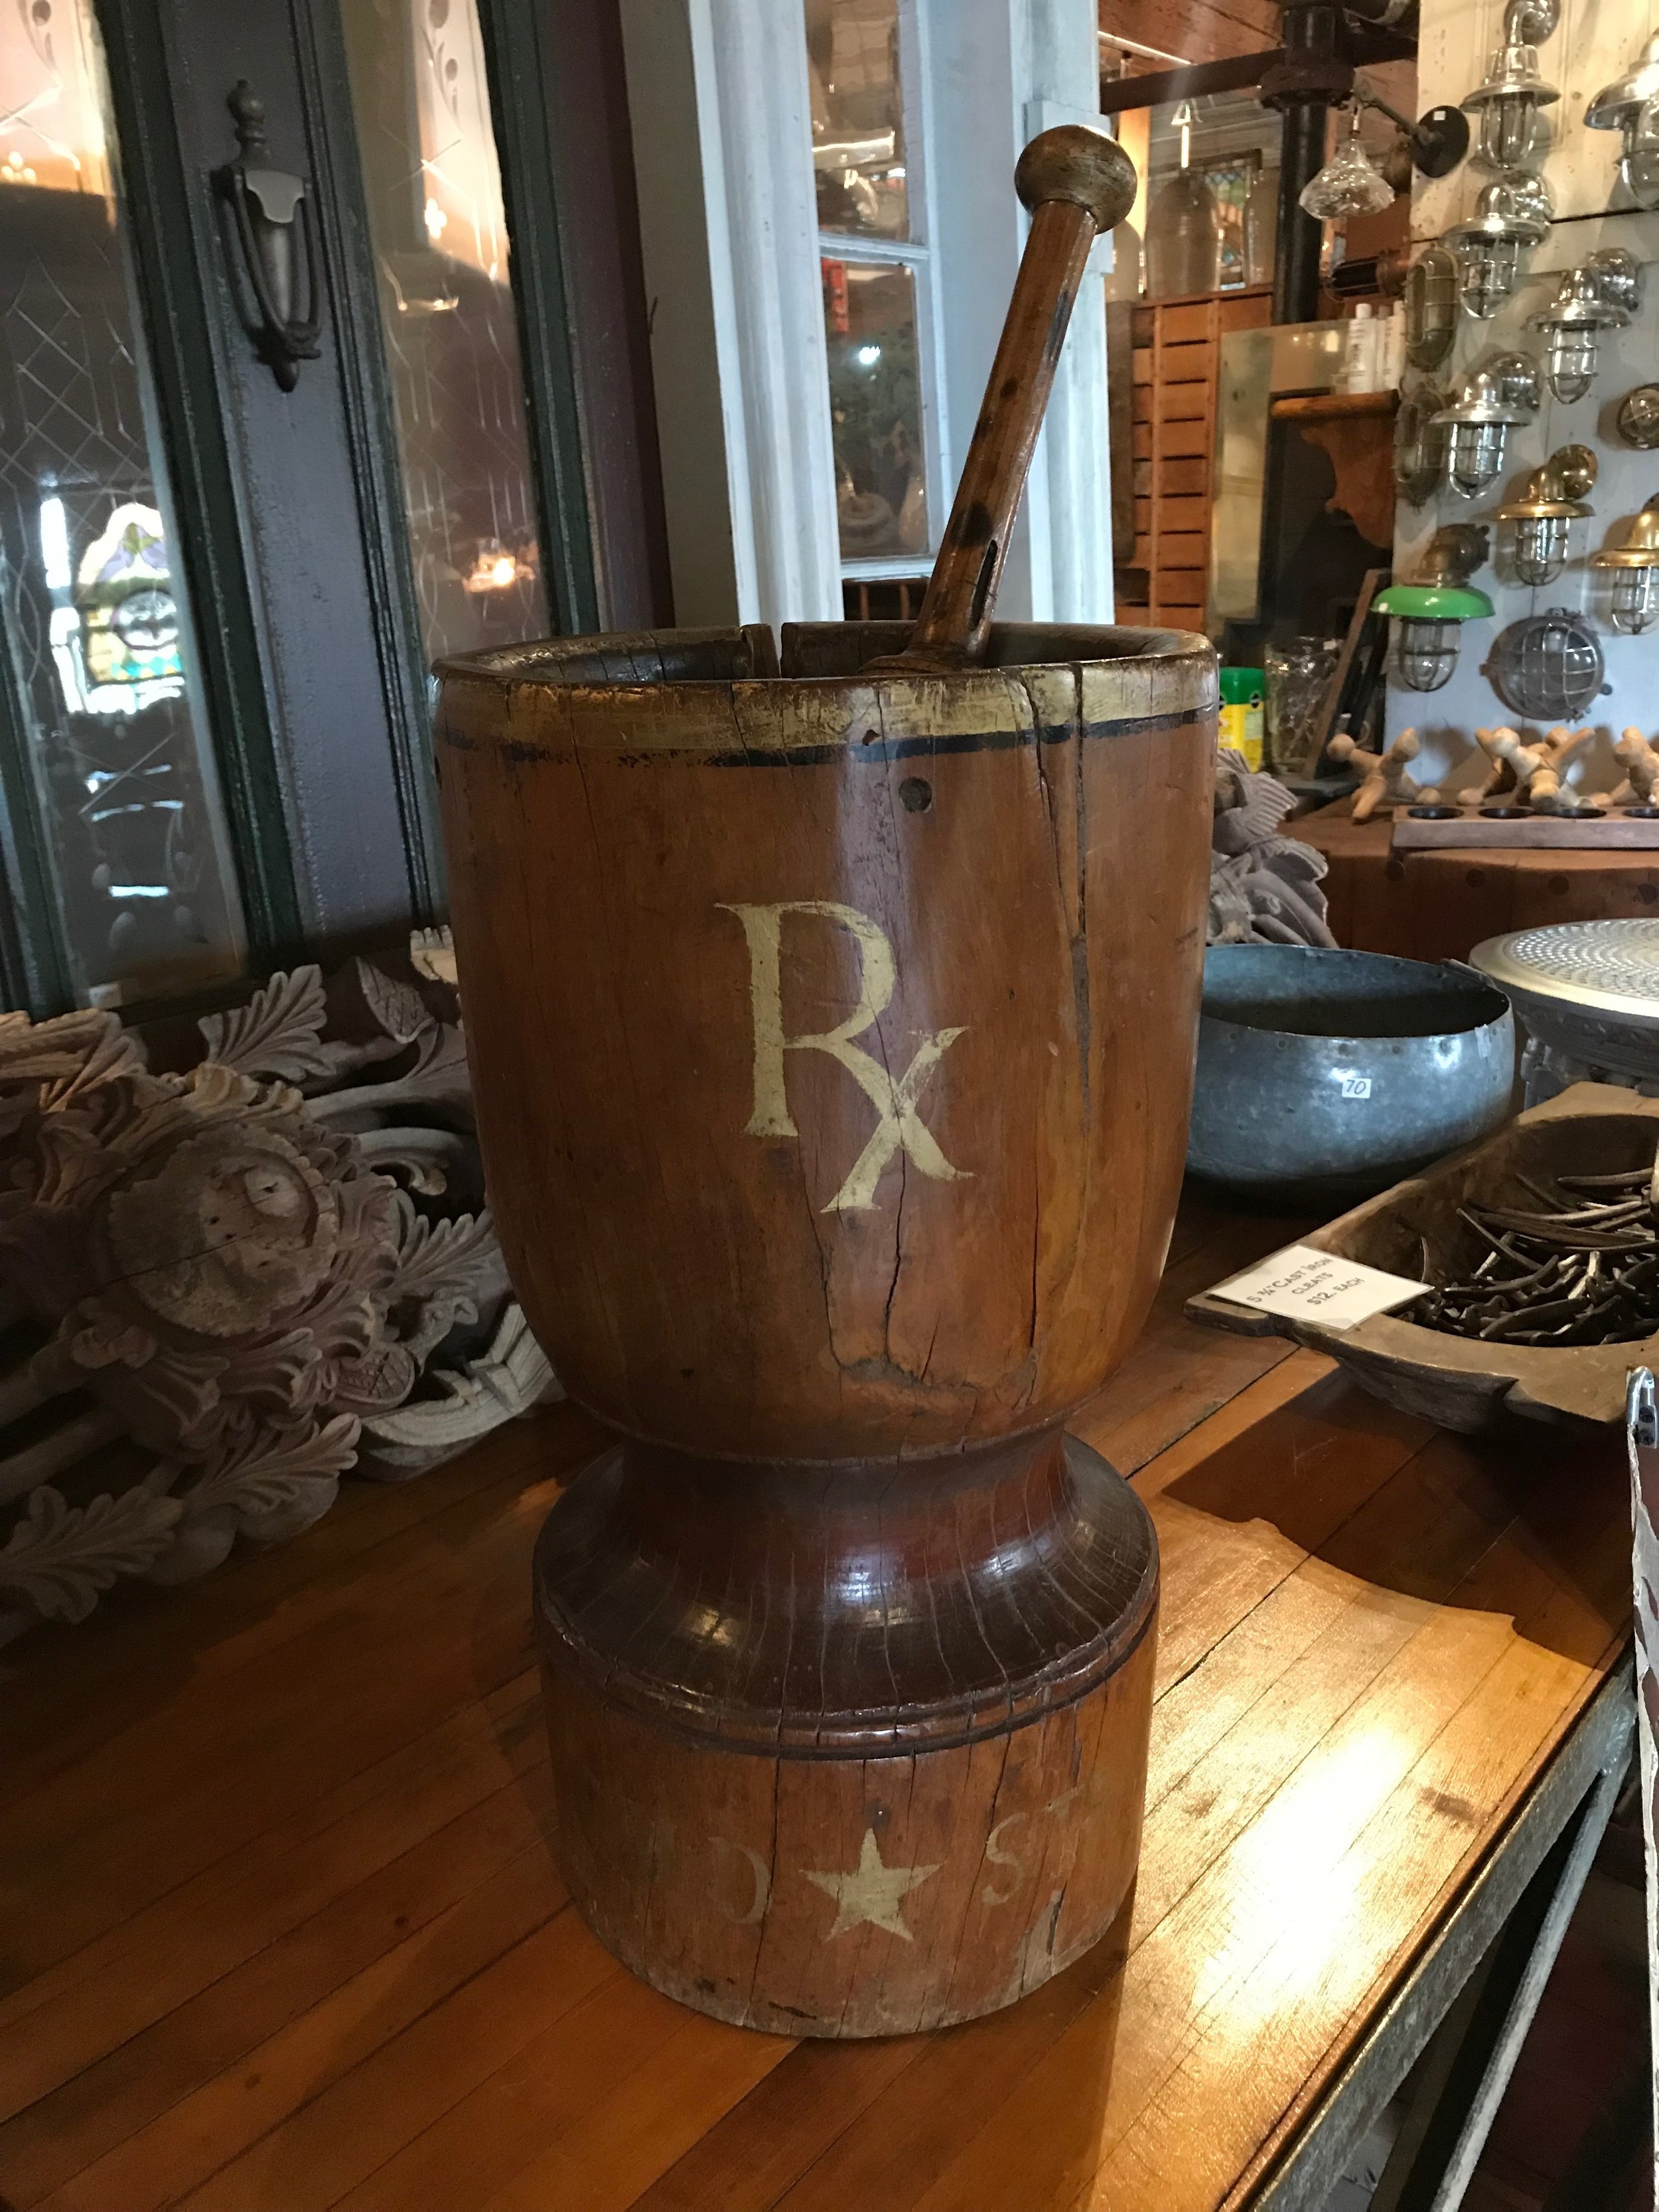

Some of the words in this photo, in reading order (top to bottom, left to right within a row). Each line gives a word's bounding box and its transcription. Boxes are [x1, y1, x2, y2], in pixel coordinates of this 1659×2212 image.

[1346, 1079, 1366, 1095] 70
[1271, 1270, 1307, 1288] CAST
[1291, 1272, 1333, 1295] CLEATS
[1333, 1278, 1365, 1291] EACH
